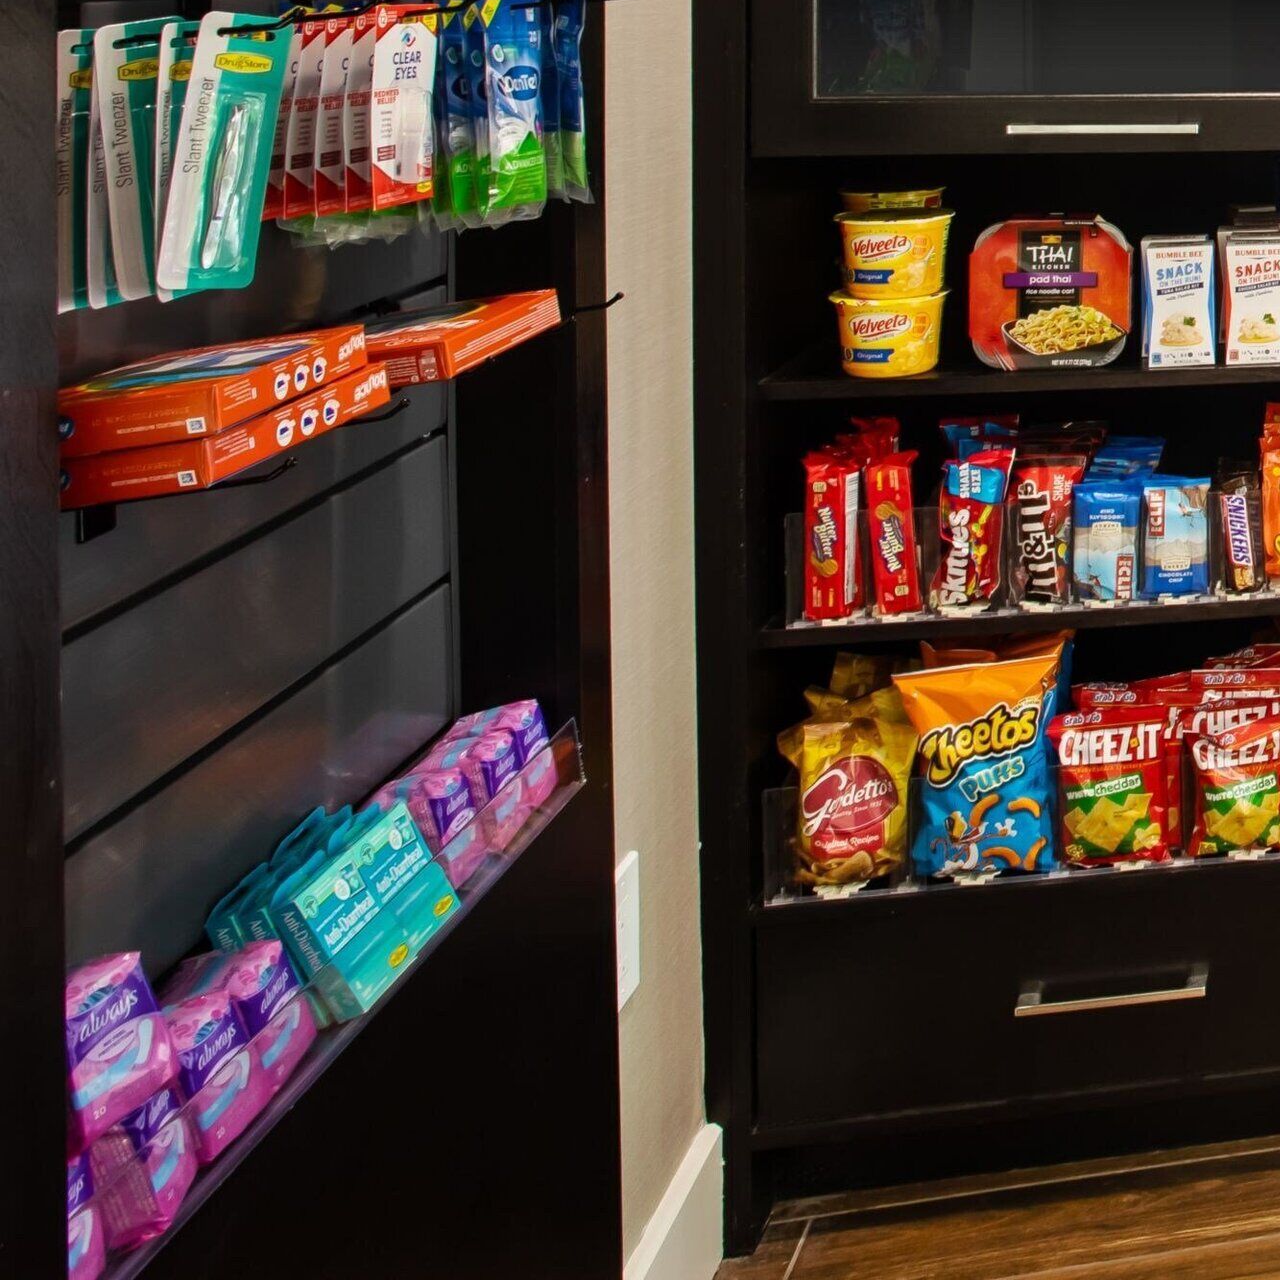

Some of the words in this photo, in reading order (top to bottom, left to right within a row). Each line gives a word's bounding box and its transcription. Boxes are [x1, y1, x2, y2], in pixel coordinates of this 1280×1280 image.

[392, 50, 422, 67] CLEAR
[394, 65, 417, 81] EYES
[192, 76, 216, 134] Tweezer
[374, 87, 399, 98] REDNESS
[377, 95, 397, 105] RELIEF
[111, 90, 131, 149] Tweezer
[182, 131, 206, 176] Slant
[114, 153, 135, 191] Slant
[852, 234, 908, 256] Velveeta
[1026, 245, 1074, 263] THAI
[1156, 251, 1188, 259] BUMBLE
[1189, 250, 1204, 258] BEE
[1235, 249, 1267, 257] BUMBLE
[857, 272, 883, 282] Original
[1029, 275, 1050, 285] pad
[1052, 275, 1072, 284] thai
[1156, 262, 1203, 280] SNACK
[850, 314, 908, 336] Velveeta
[857, 351, 883, 361] Original
[971, 468, 982, 494] SIZE
[1052, 474, 1065, 501] SHARE
[818, 507, 838, 541] Nutter
[1226, 497, 1251, 565] SNICKERS
[813, 524, 833, 558] Butter
[882, 521, 904, 555] Butter
[879, 539, 902, 573] Nutter
[1204, 674, 1224, 684] Grab
[1093, 692, 1114, 703] Grab
[1064, 714, 1085, 726] Grab
[918, 703, 1041, 787] Cheetos
[1058, 722, 1163, 767] CHEEZ-IT
[959, 756, 1025, 802] PUFFS
[1095, 775, 1142, 797] cheddar
[1233, 776, 1276, 798] cheddar
[375, 842, 424, 893] Anti-Diarrheal
[324, 892, 376, 947] Anti-Diarrheal
[261, 968, 290, 1014] always
[80, 989, 139, 1042] always
[199, 1022, 237, 1069] always
